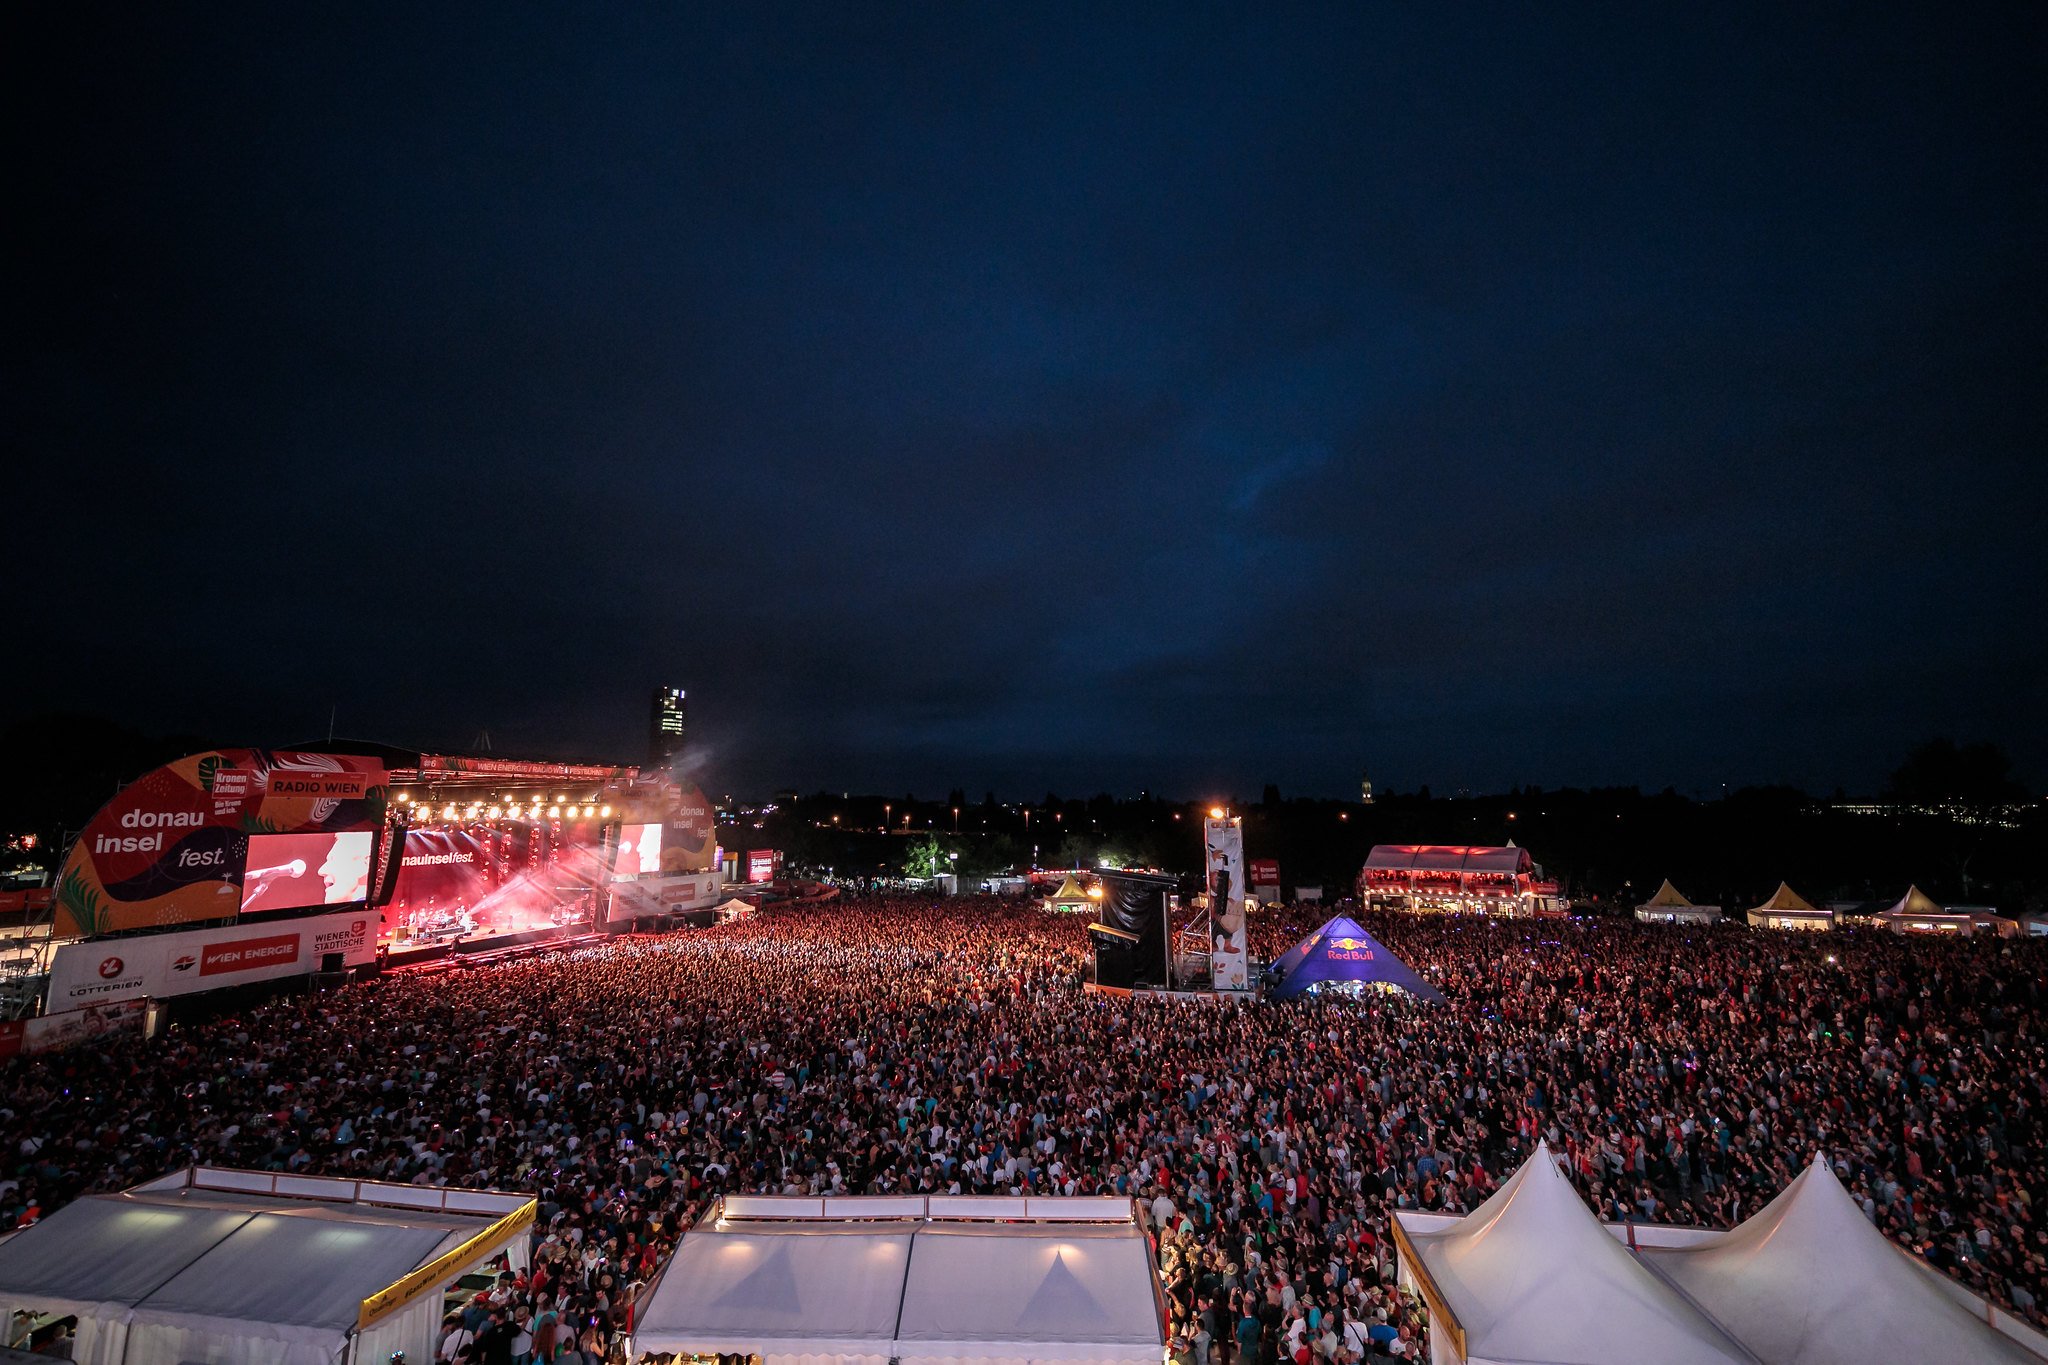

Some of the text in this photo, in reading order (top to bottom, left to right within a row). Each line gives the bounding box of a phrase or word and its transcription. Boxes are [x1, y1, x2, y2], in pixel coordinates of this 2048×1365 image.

[477, 762, 496, 771] WIEN
[497, 763, 527, 773] ENERGIE
[216, 773, 247, 784] Kronen
[215, 783, 246, 795] Zeitung
[273, 781, 361, 794] RADIO WIEN
[680, 805, 705, 816] donau
[121, 808, 205, 828] donau
[673, 818, 693, 829] insel
[95, 832, 163, 854] insel
[178, 847, 225, 868] fest.
[401, 851, 474, 867] nauinselfest.
[315, 930, 350, 943] WIENER
[206, 944, 294, 965] WIEN ENERGIE
[1327, 950, 1374, 960] Red Bull
[69, 980, 143, 997] LOTTERIEN
